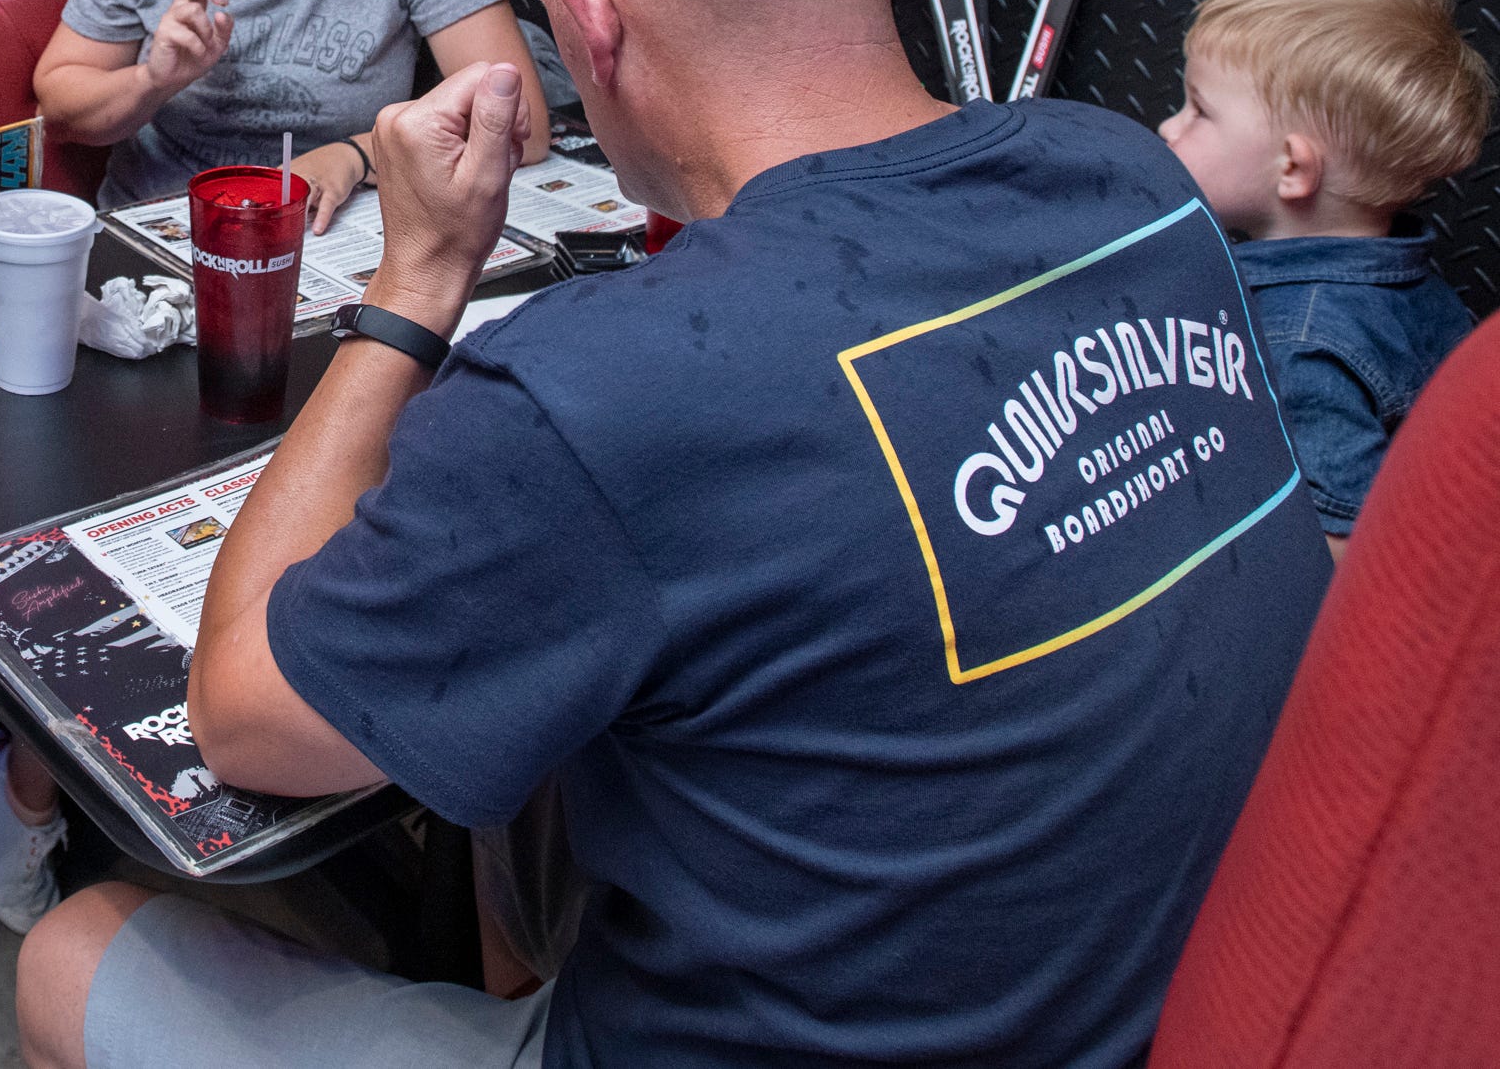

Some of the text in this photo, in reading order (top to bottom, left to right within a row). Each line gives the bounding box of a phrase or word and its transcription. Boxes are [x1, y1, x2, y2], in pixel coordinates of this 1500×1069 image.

[269, 255, 294, 269] SUSHI
[1078, 409, 1175, 484] ORIGINAL
[1044, 426, 1225, 553] BOARDSHORT CO
[87, 511, 156, 538] OPENING
[157, 497, 196, 515] ACTS
[157, 720, 196, 746] RO
